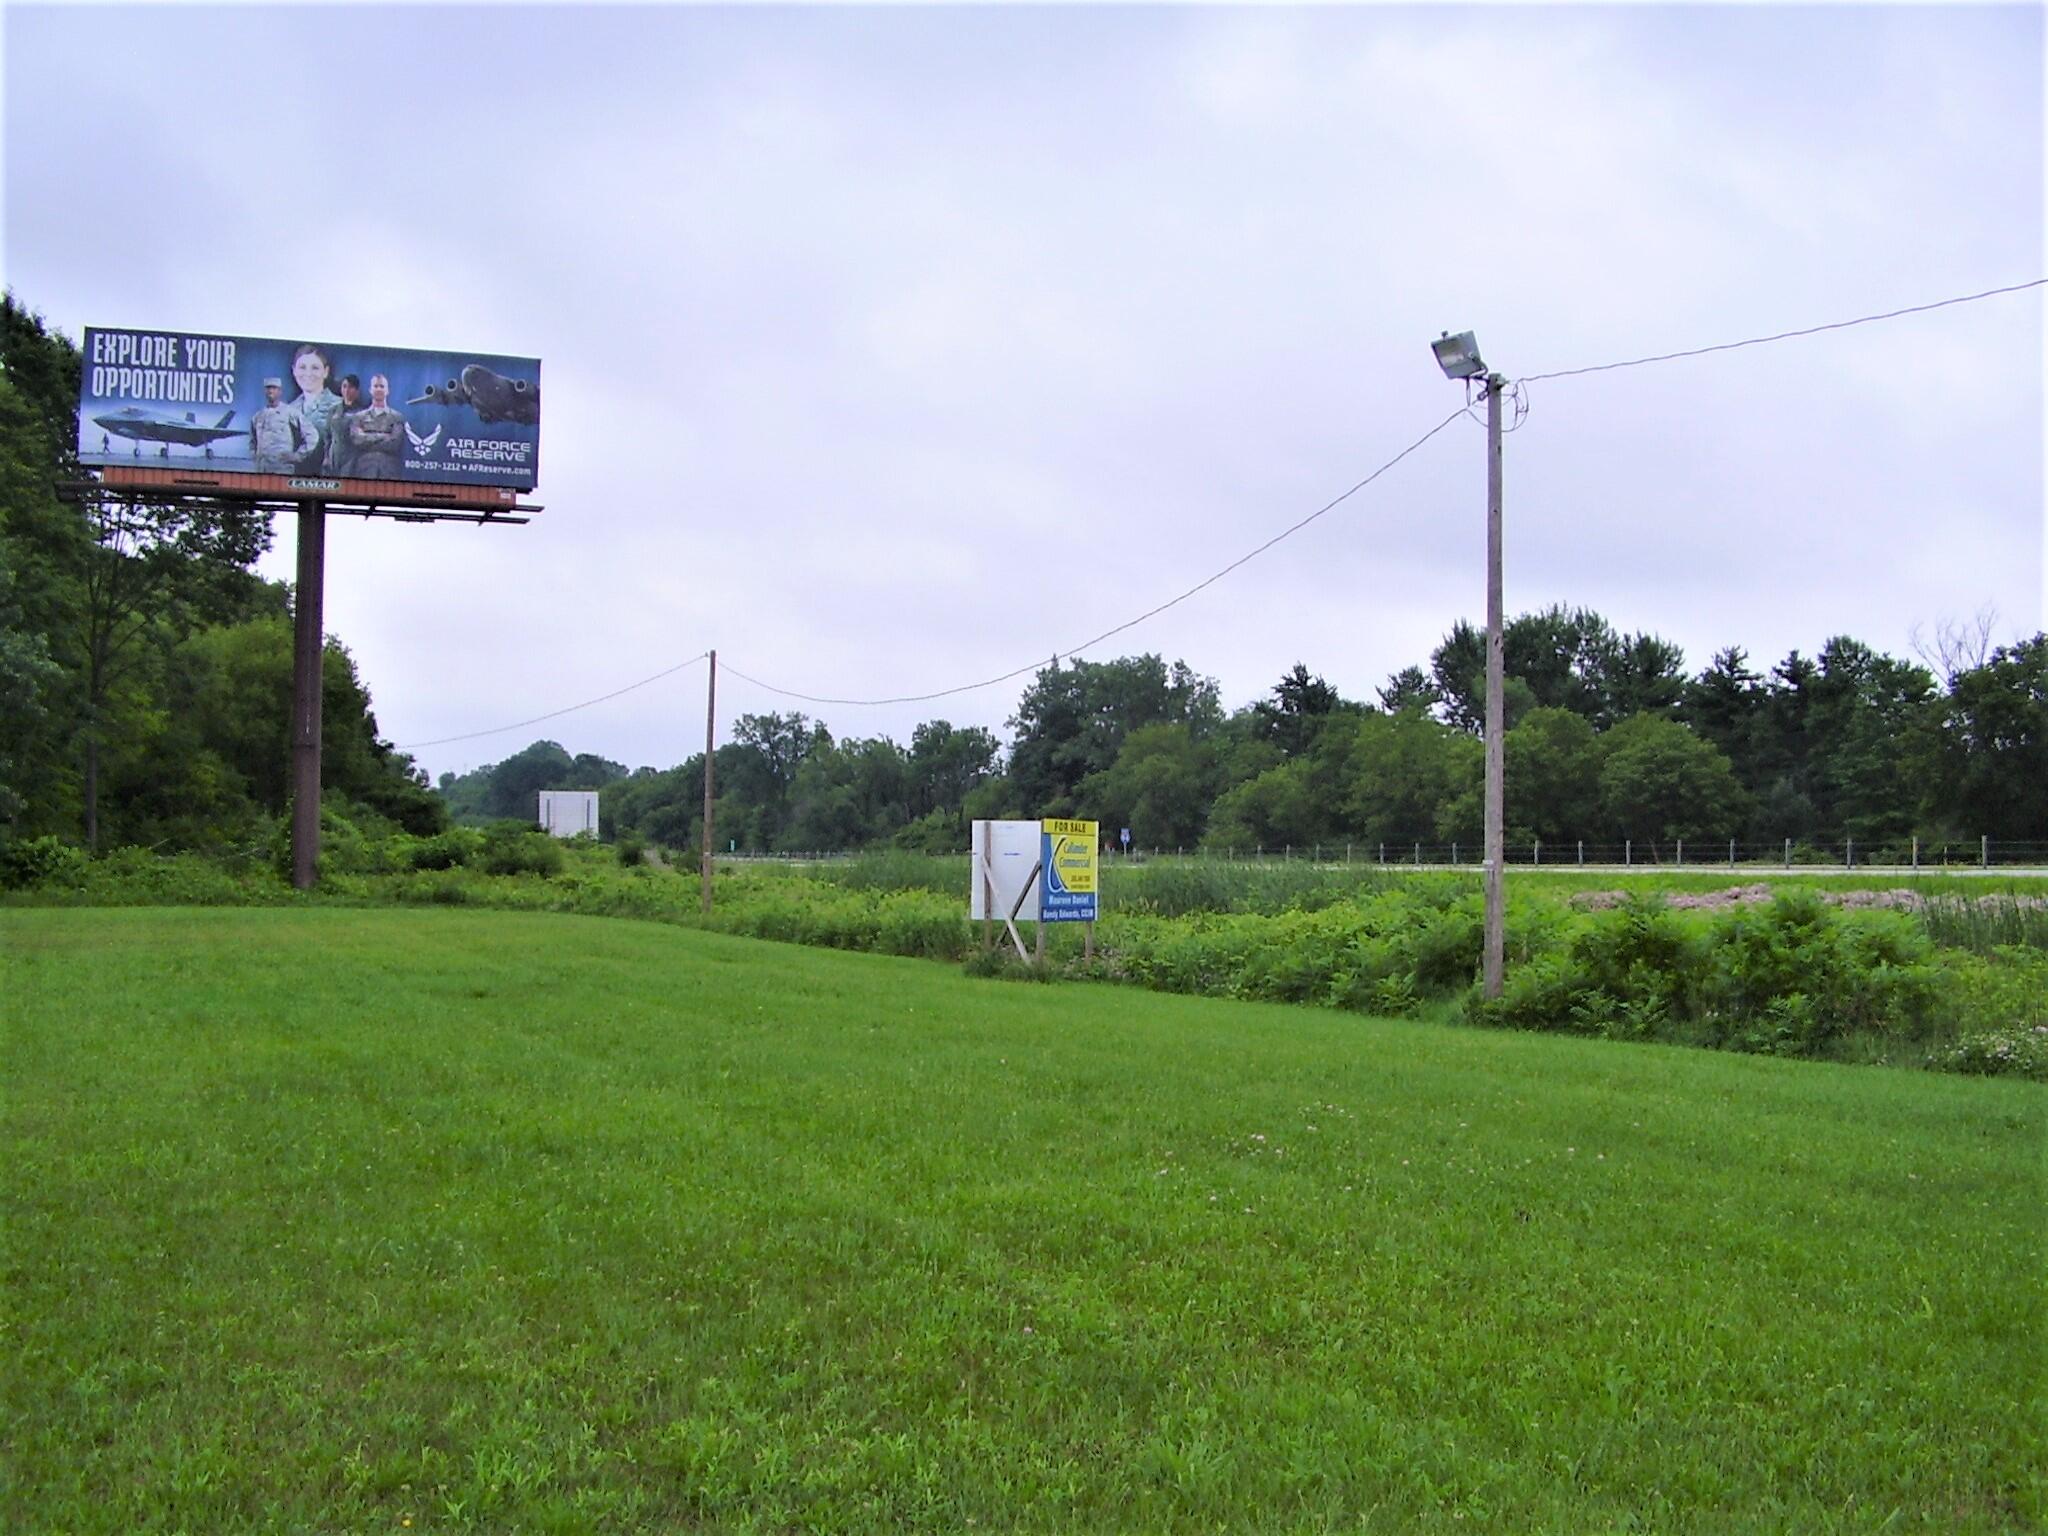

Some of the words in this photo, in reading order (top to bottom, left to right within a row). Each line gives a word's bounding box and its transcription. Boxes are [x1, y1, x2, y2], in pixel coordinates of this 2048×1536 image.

[93, 333, 178, 368] EXPLORE
[185, 338, 236, 371] YOUR
[91, 366, 235, 404] OPPORTUNITIES
[446, 438, 475, 449] AIR
[478, 440, 531, 452] FORCE
[451, 448, 526, 462] RESERVE
[404, 460, 460, 471] 800-257-1212
[468, 463, 532, 475] AFReserve.com
[291, 479, 336, 489] LAMAR
[1054, 821, 1069, 832] FOR
[1070, 822, 1087, 833] SALE
